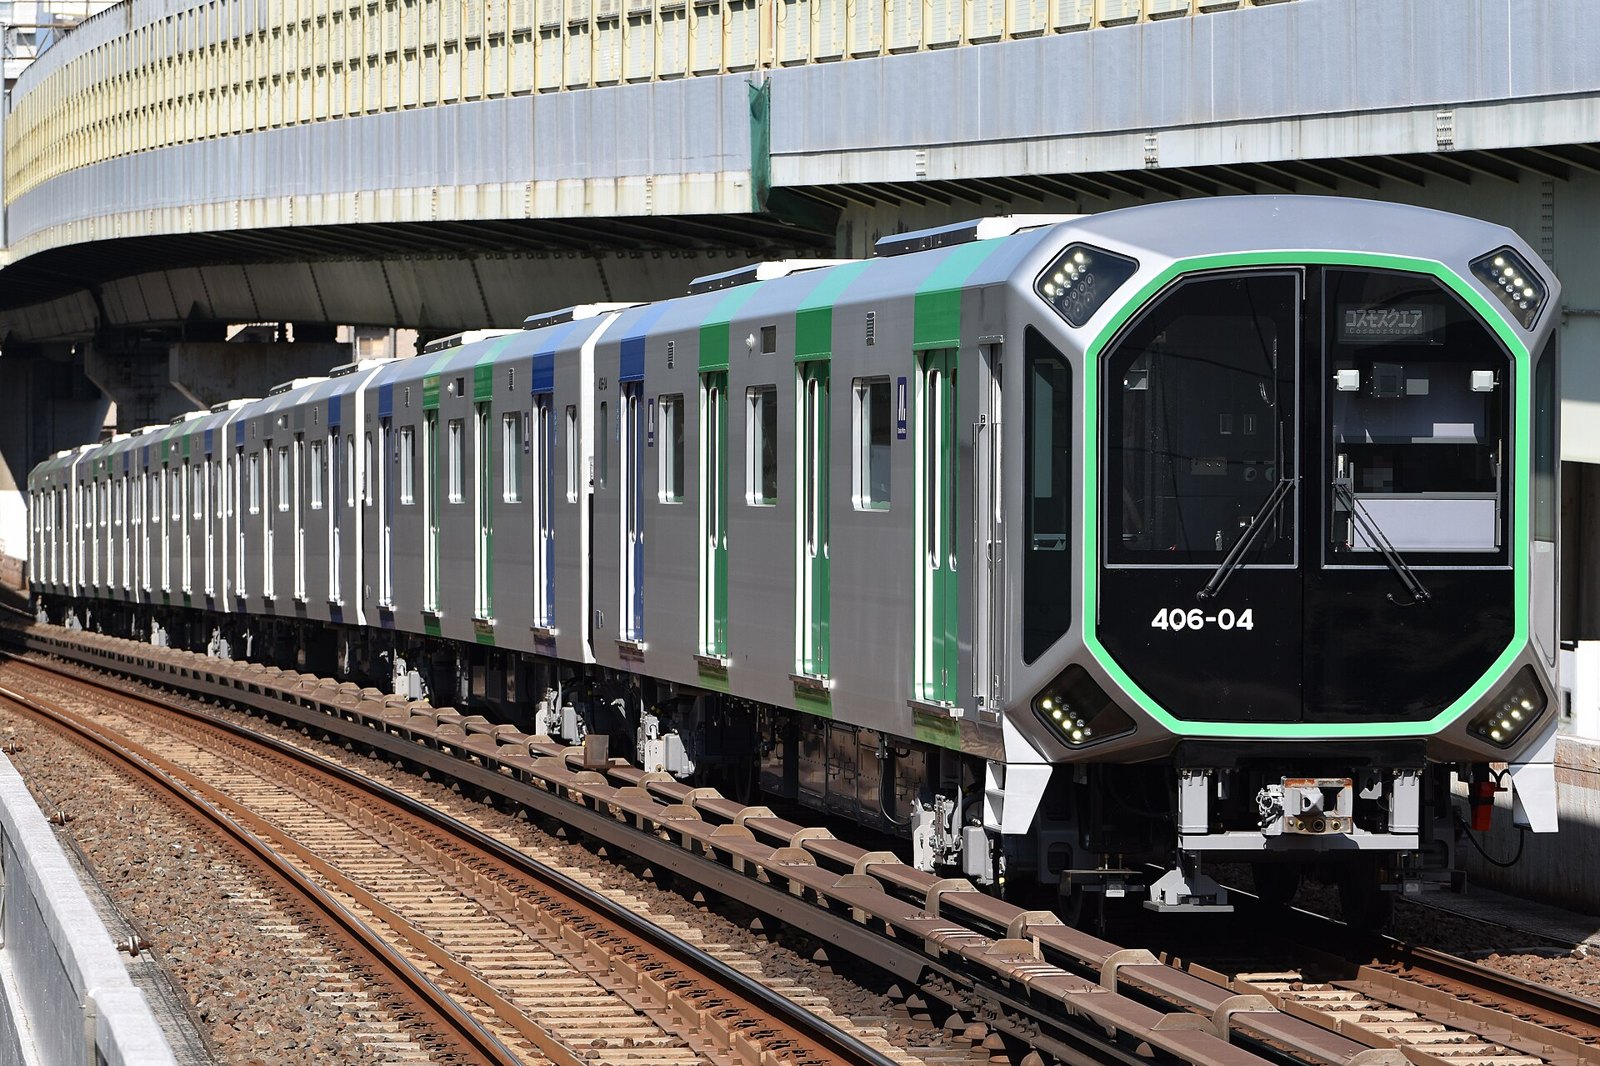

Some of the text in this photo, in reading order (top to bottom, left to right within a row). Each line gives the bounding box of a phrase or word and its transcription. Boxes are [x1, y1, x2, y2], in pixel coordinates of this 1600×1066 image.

[1345, 308, 1423, 328] コスモスクエア
[1151, 608, 1254, 631] 406-04
